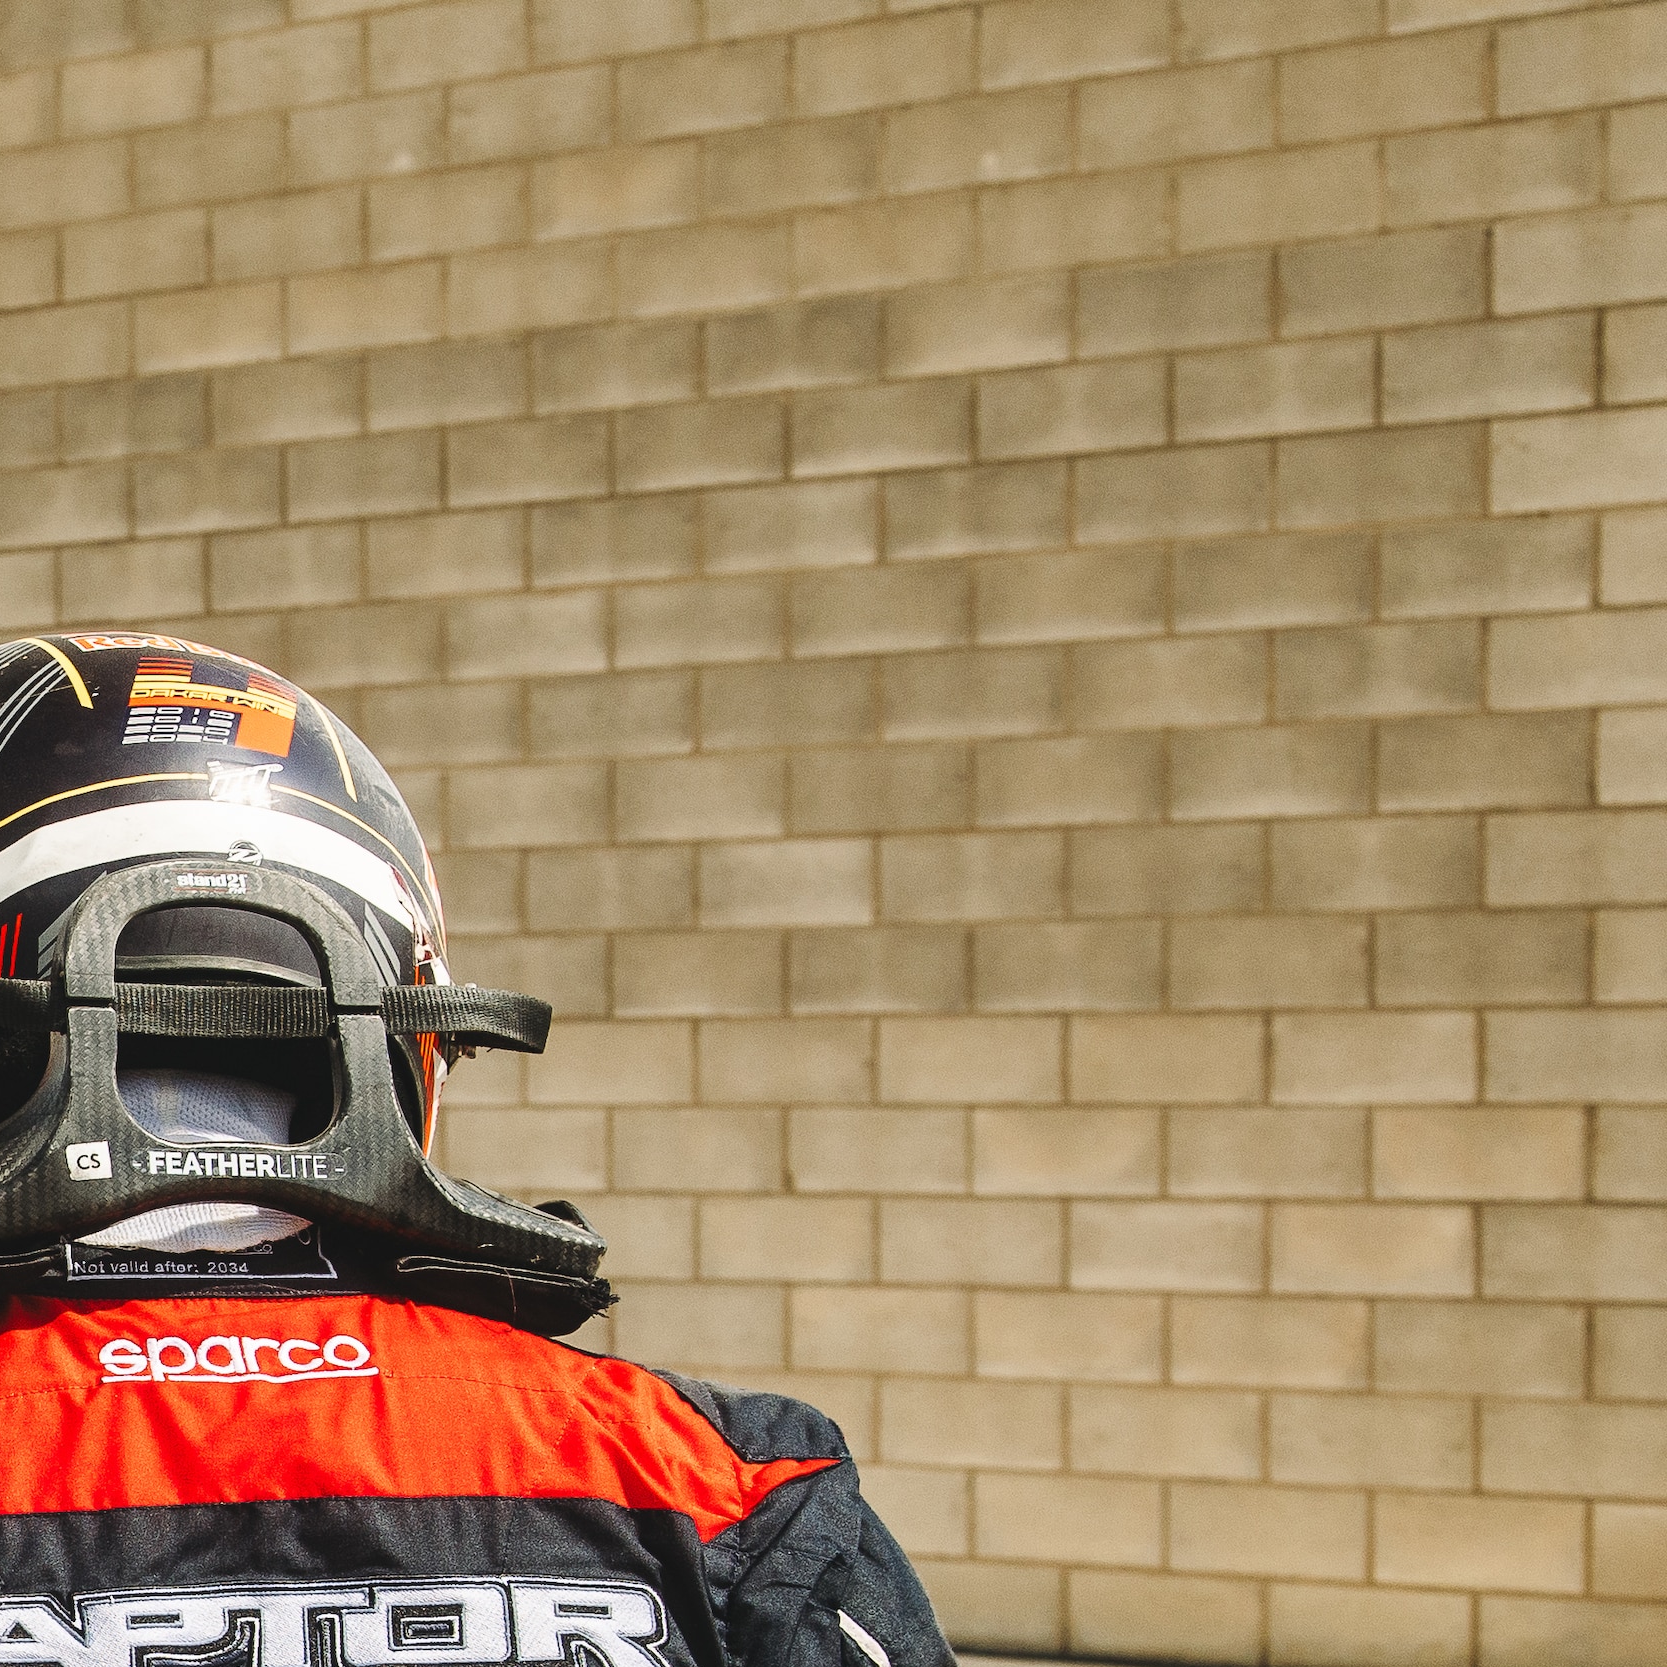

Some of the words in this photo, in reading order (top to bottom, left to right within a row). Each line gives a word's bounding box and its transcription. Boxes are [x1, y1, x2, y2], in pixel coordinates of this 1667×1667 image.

[130, 689, 227, 703] DAKAR
[177, 872, 247, 888] stand21
[77, 1154, 101, 1170] CS
[148, 1150, 327, 1178] FEATHERLITE
[73, 1261, 105, 1274] Not
[111, 1260, 149, 1274] valid
[154, 1260, 199, 1274] after:
[207, 1261, 249, 1274] 2034
[99, 1333, 378, 1384] sparco
